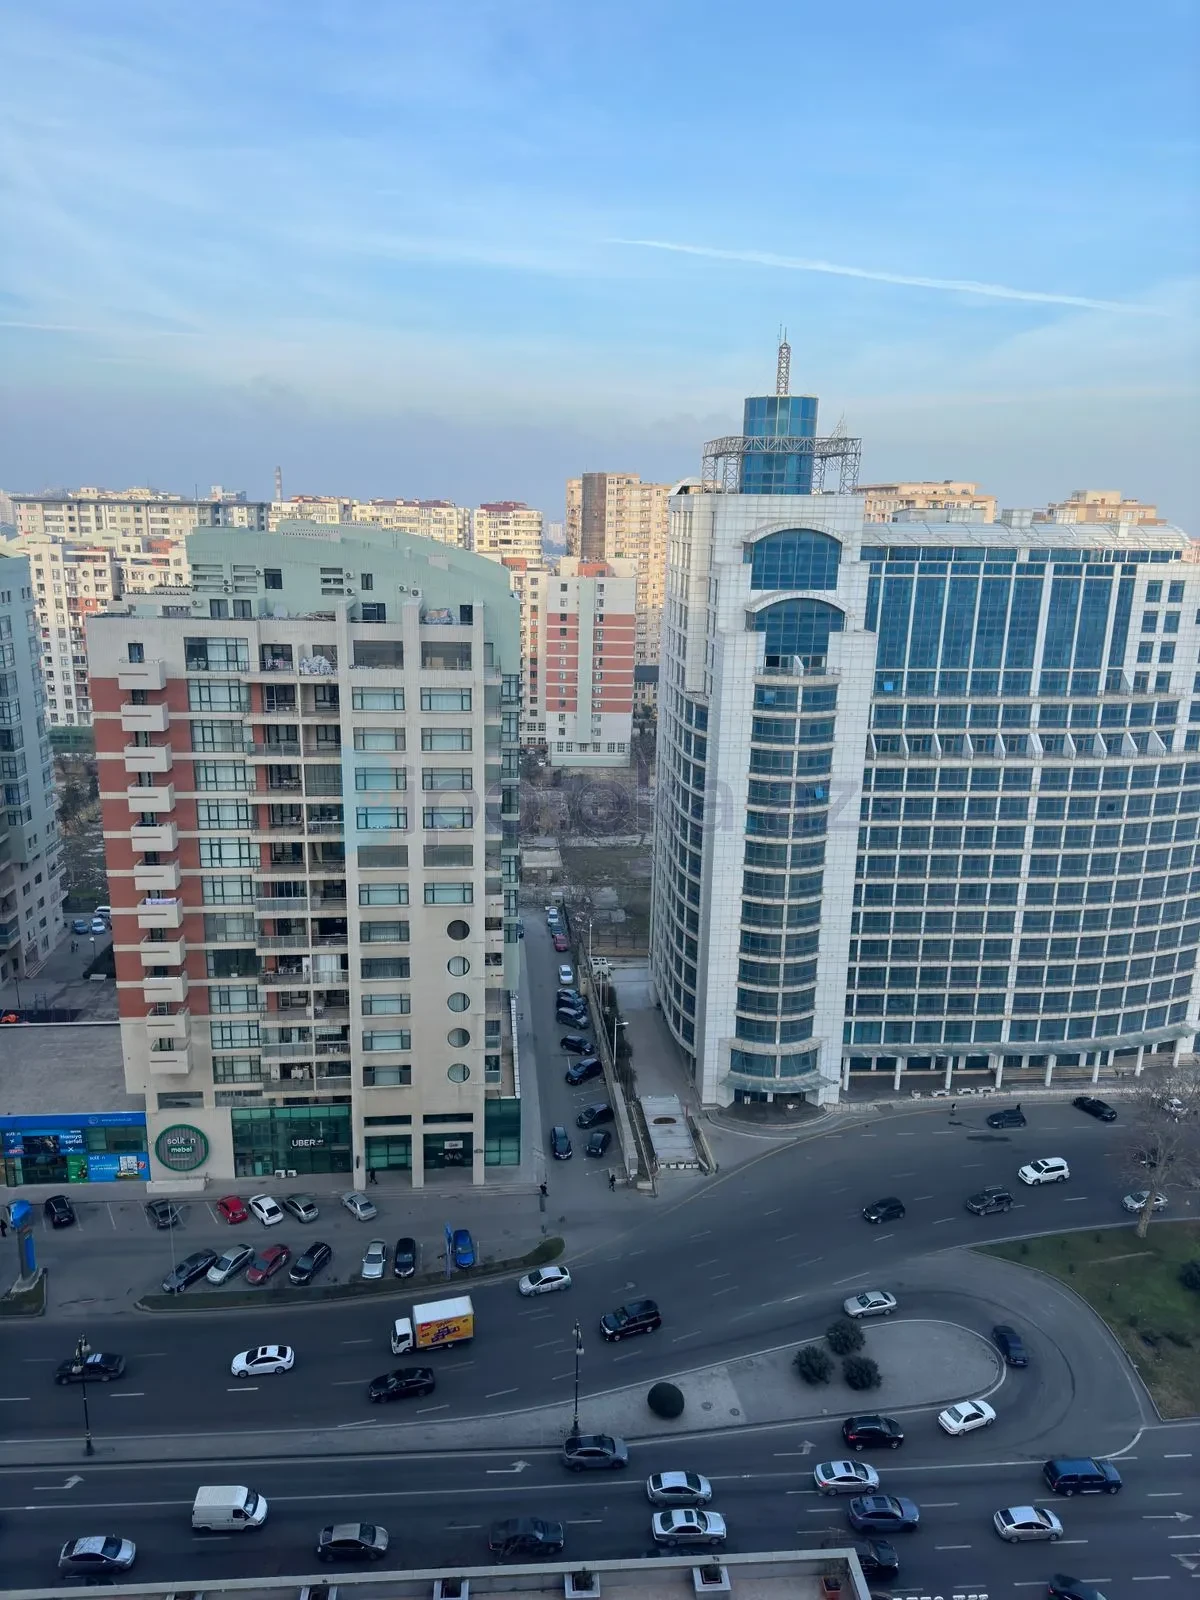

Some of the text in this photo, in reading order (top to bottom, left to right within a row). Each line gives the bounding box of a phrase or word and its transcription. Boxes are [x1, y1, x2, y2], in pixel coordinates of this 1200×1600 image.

[167, 1136, 196, 1145] solitn
[292, 1139, 316, 1147] UBER
[171, 1145, 193, 1153] mebel
